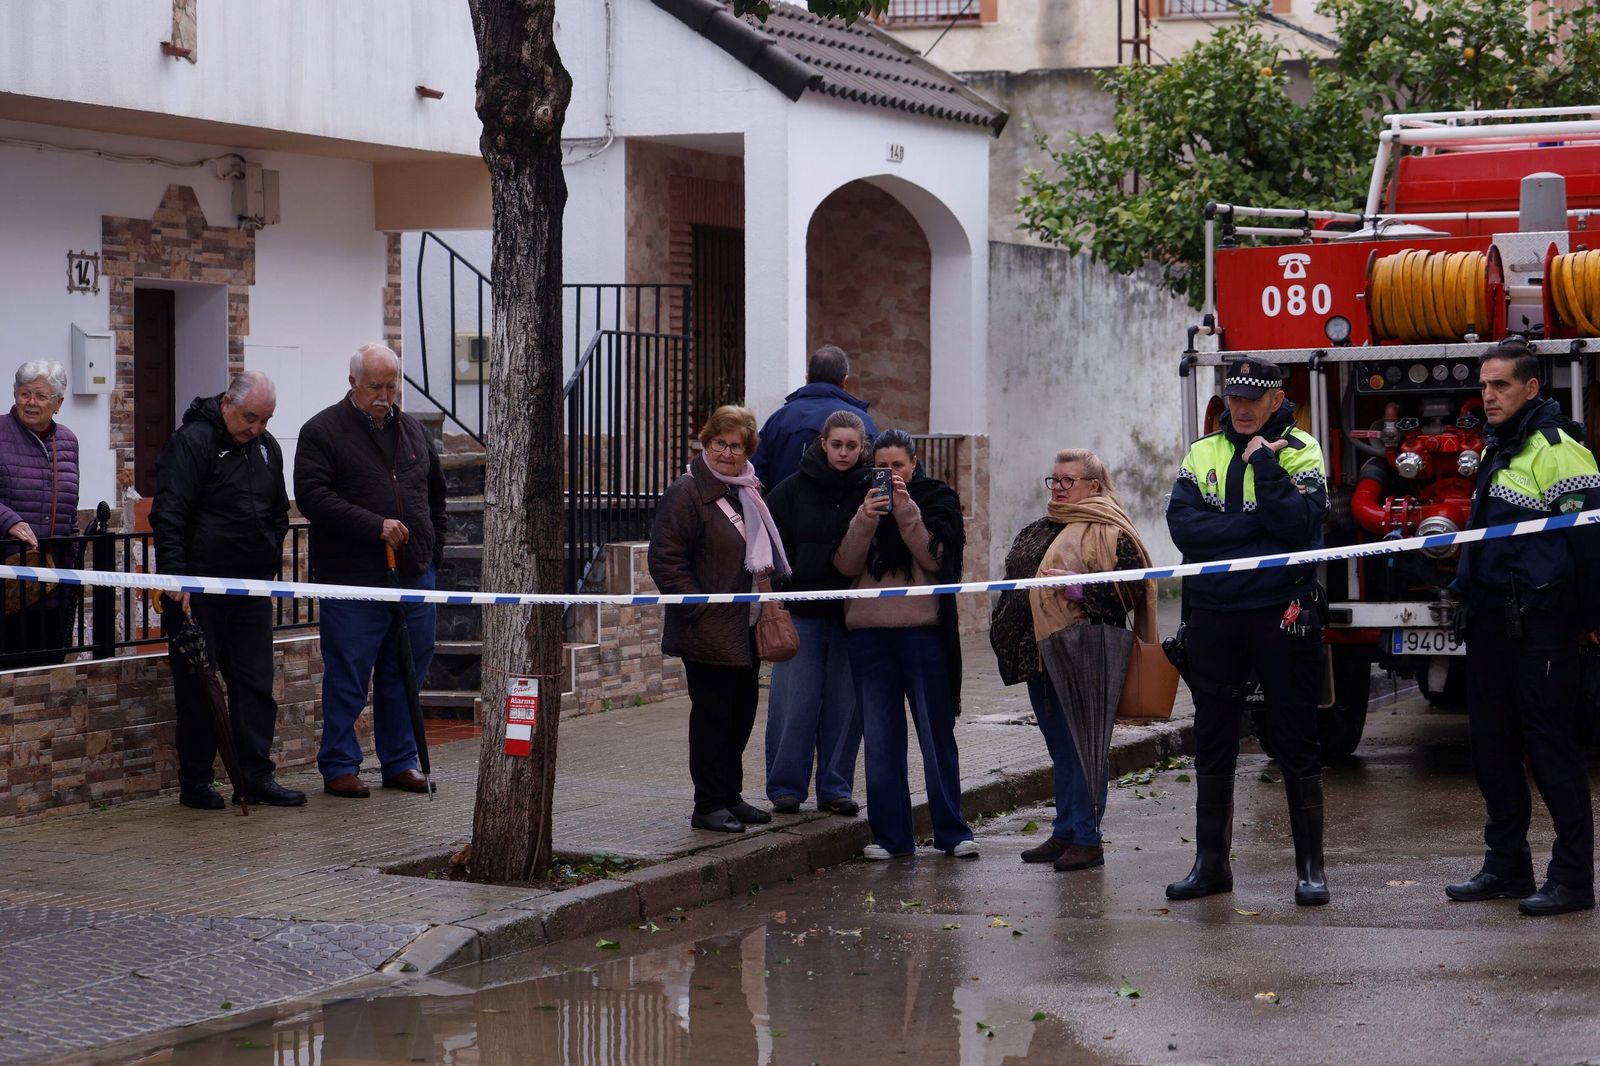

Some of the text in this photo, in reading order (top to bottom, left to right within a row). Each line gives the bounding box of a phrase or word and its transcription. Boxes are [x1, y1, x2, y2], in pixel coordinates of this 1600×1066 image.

[75, 260, 90, 286] 14
[1261, 283, 1331, 317] 080
[1407, 631, 1459, 651] 9405
[510, 697, 535, 705] Alarma
